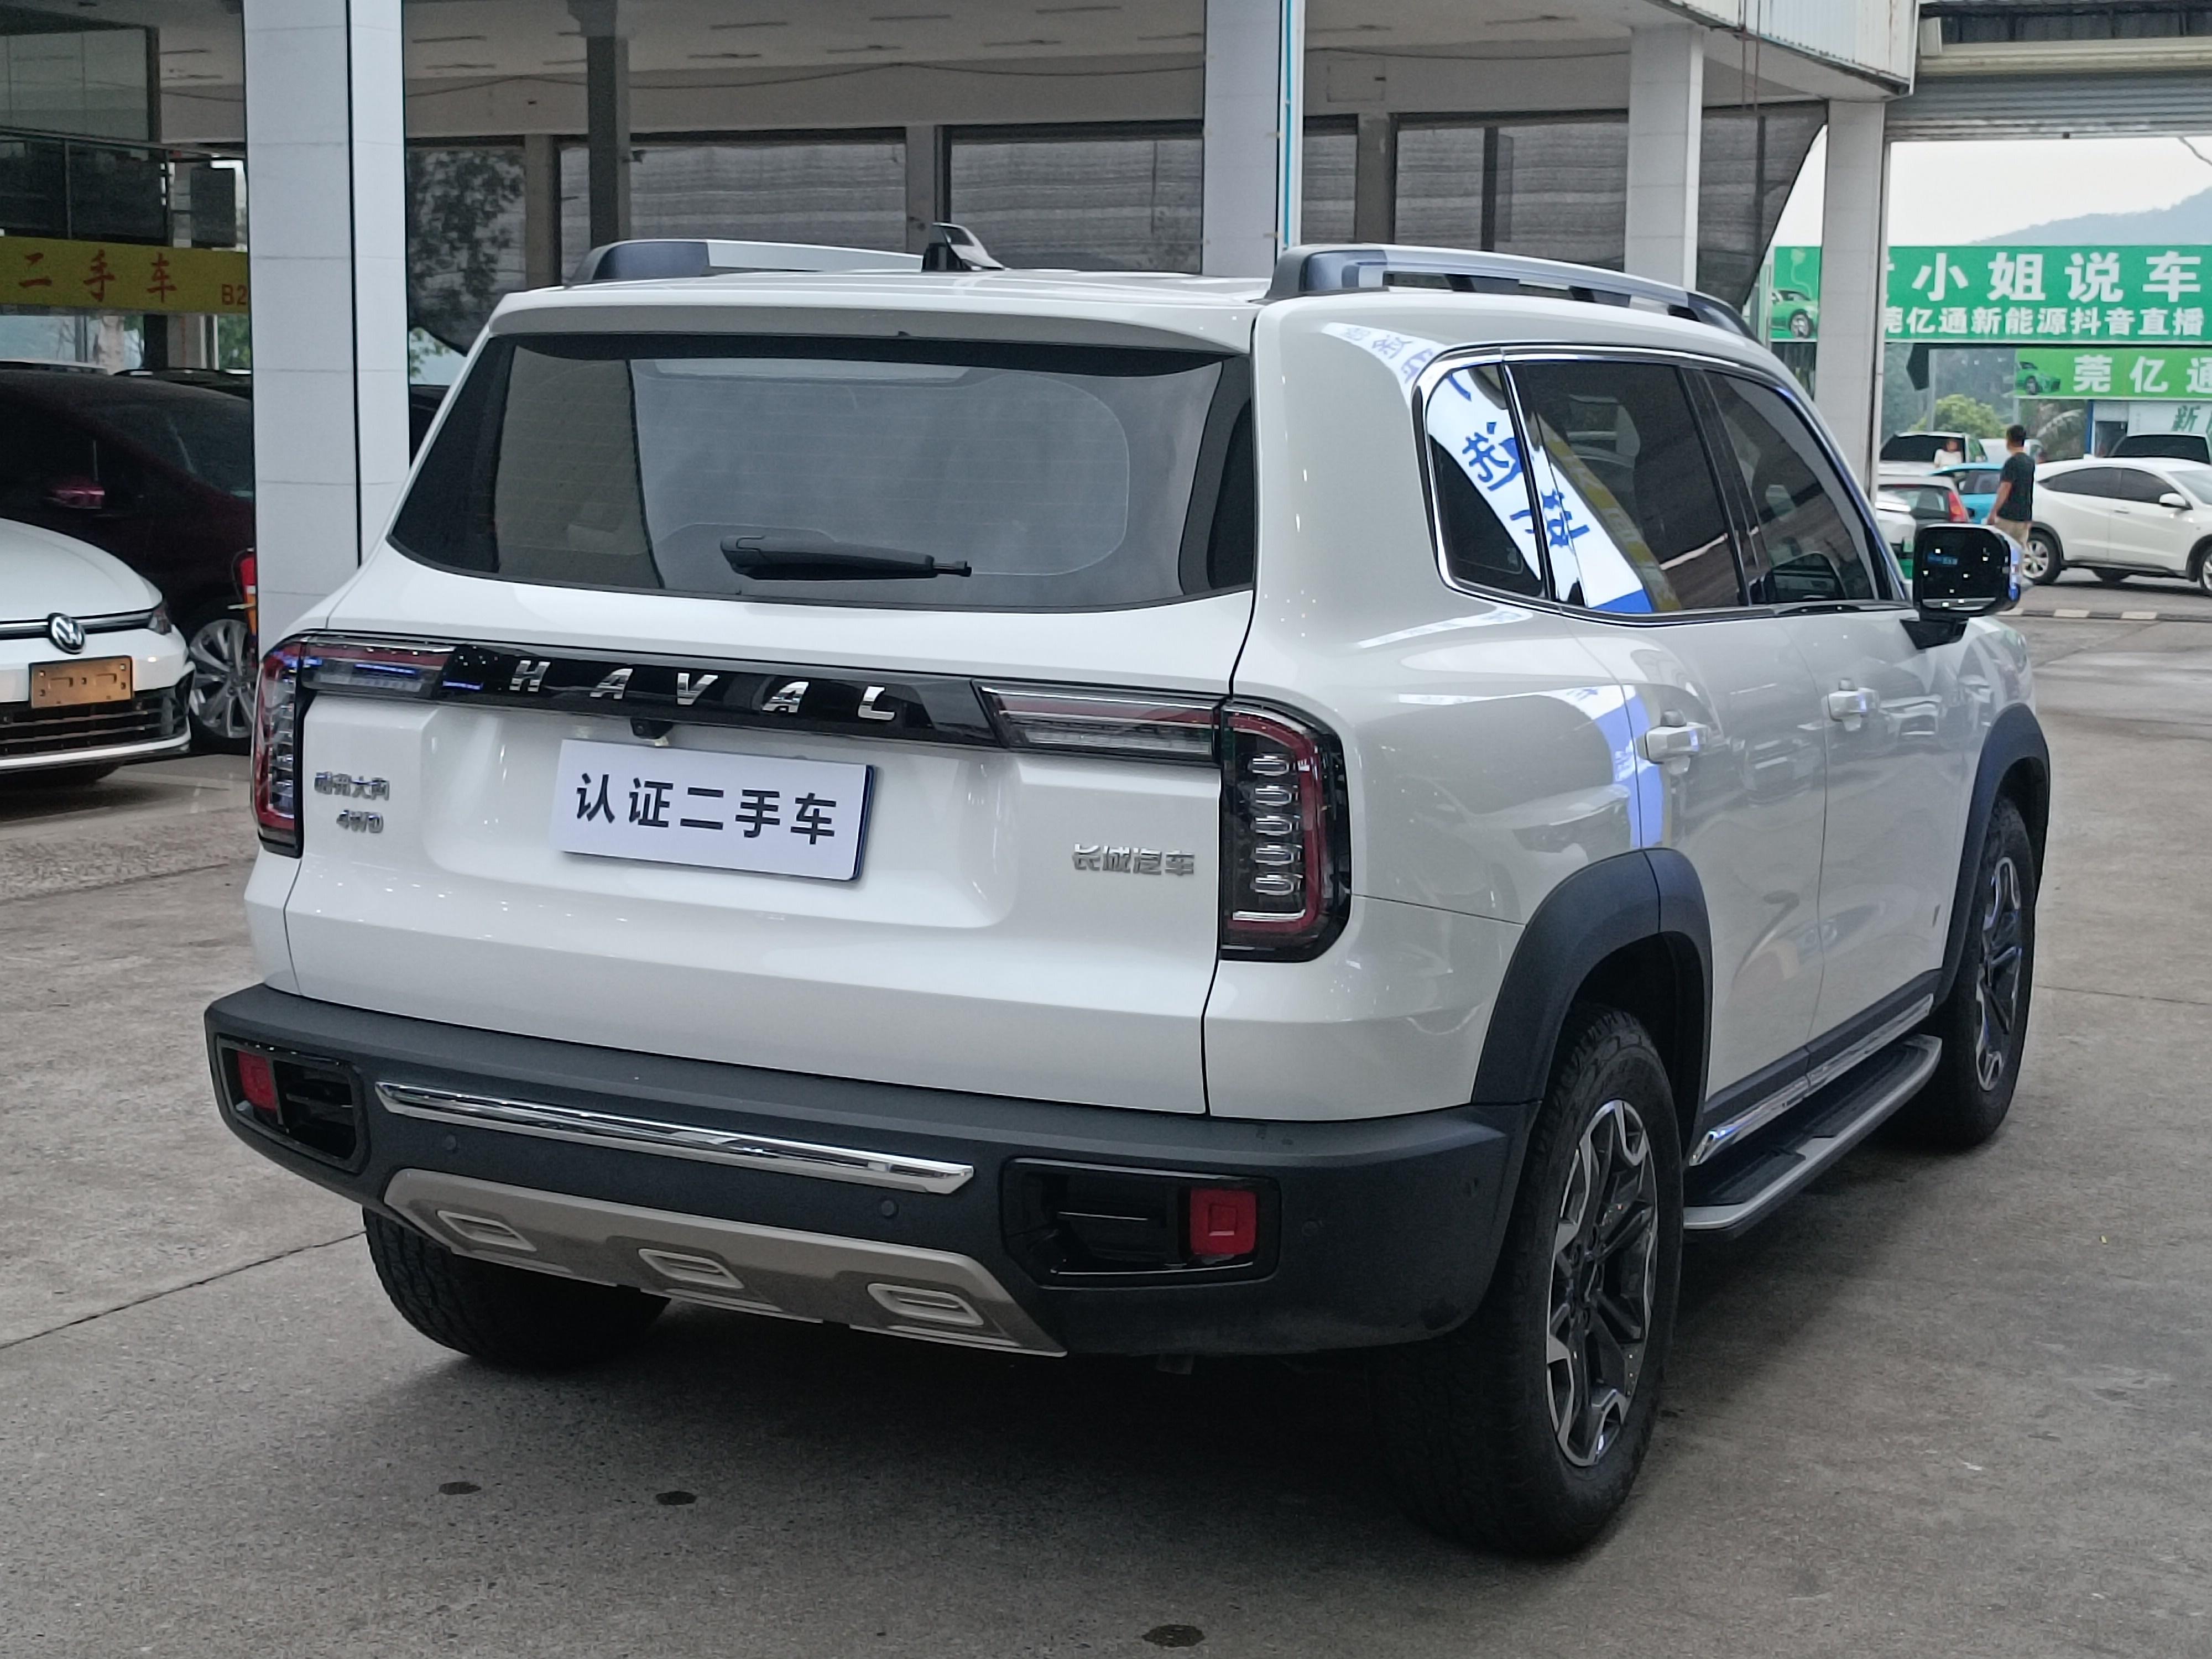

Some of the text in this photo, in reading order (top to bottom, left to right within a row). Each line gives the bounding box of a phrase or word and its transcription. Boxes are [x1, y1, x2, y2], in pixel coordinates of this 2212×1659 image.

[19, 249, 177, 302] 二手车
[1886, 251, 2201, 302] 小姐说车
[2073, 354, 2212, 393] 莞亿通
[509, 660, 895, 721] HAVAL
[336, 809, 384, 834] 4WD
[577, 773, 837, 846] 认证二手车
[1072, 843, 1195, 876] 长城汽车
